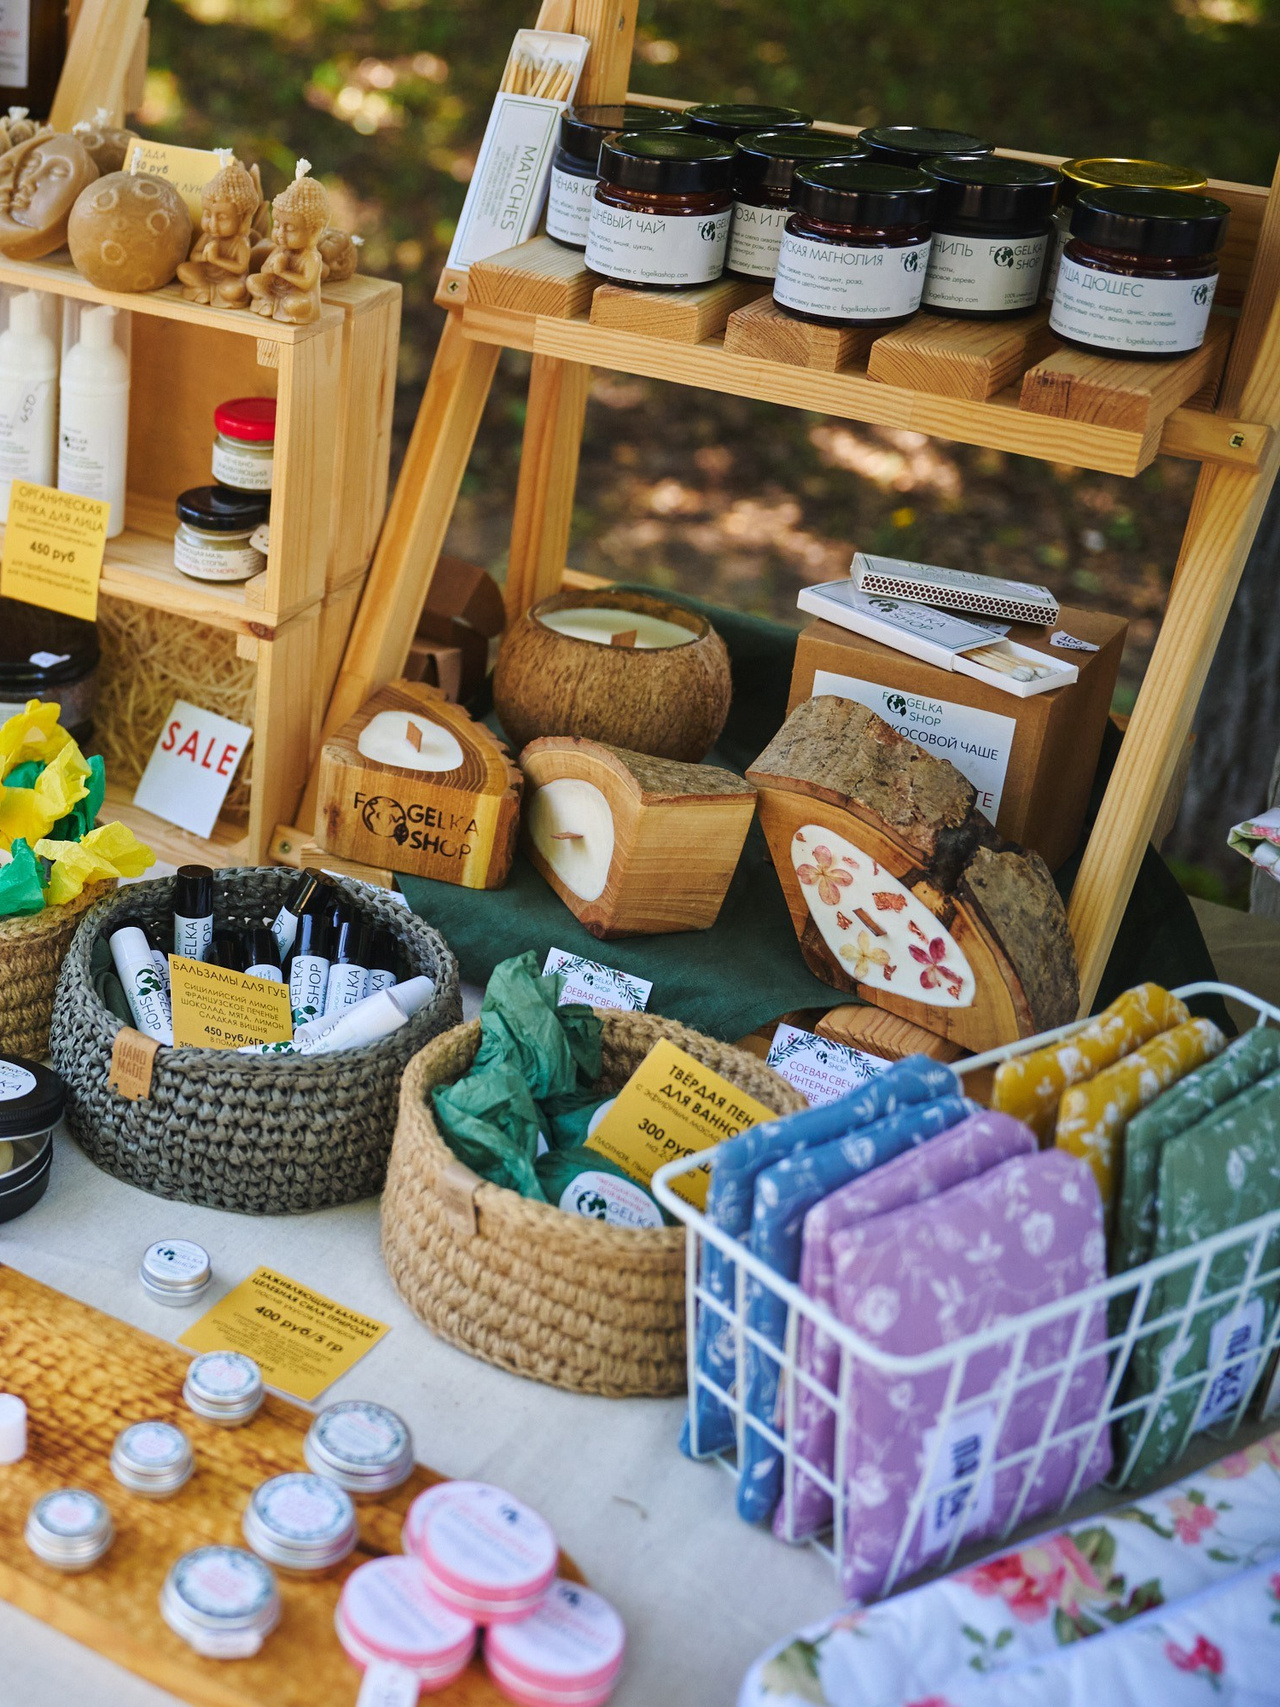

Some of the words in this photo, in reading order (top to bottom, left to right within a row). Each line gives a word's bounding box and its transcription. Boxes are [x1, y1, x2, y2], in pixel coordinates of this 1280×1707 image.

[501, 144, 538, 231] MATCHES
[636, 219, 666, 234] ЧАЙ
[809, 247, 884, 267] МАГНОЛИЯ
[1015, 256, 1041, 270] SHOP
[613, 266, 632, 275] вместе
[640, 267, 689, 279] fogelkashop.com
[846, 278, 864, 287] роза,
[927, 291, 979, 303] fogelkashop.com
[1081, 273, 1145, 299] ДЮШЕС
[811, 302, 830, 311] вместе
[840, 303, 891, 316] fogelkashop.com
[1125, 337, 1178, 347] fogelkashop.com
[20, 394, 37, 424] 450
[19, 486, 103, 517] ОРГАНИЧЕСКАЯ
[13, 500, 46, 516] ПЕНКА
[49, 511, 71, 523] ДЛЯ
[74, 516, 105, 533] ЛИЦА
[30, 541, 51, 556] 450
[52, 549, 76, 564] руб
[889, 612, 935, 632] SHOP
[909, 711, 942, 727] SHOP
[161, 719, 239, 779] SALE
[960, 740, 999, 761] ЧАШЕ
[408, 831, 472, 860] SHOP
[173, 960, 239, 987] БАЛЬЗАМЫ
[241, 980, 265, 994] ДЛЯ
[268, 985, 287, 999] ГУБ
[307, 963, 322, 1006] SHOP
[593, 982, 611, 993] SHOP
[184, 982, 247, 1005] СИЦИЛИЙСКИЙ
[249, 1000, 279, 1013] ЛИМОН
[185, 991, 245, 1012] ФРАНЦУЗСКОЕ
[246, 1007, 279, 1021] ПЕЧЕНЬЕ
[140, 996, 162, 1031] SHOP
[181, 998, 225, 1016] ШОКОЛАД,
[228, 1010, 252, 1023] МЯТА,
[254, 1016, 285, 1031] ЛИМОН
[198, 1010, 238, 1027] СЛАДКАЯ
[240, 1022, 268, 1034] ВИШНЯ
[204, 1025, 222, 1038] 450
[119, 1041, 147, 1065] HAND
[116, 1057, 145, 1081] MADE
[781, 1070, 789, 1078] В
[789, 1060, 828, 1081] СОЕВАЯ
[827, 1061, 847, 1073] SHOP
[643, 1087, 689, 1122] эфирным
[659, 1084, 692, 1107] ДЛЯ
[668, 1064, 727, 1109] ТВЁРДАЯ
[726, 1103, 755, 1128] ПЕН
[638, 1117, 665, 1142] 300
[646, 1141, 657, 1152] на
[252, 1277, 299, 1303] ЦЕЛЕБНАЯ
[299, 1300, 325, 1317] СИЛА
[327, 1314, 374, 1339] ПРИРОДЫ
[259, 1271, 335, 1311] ЗАЖИВЛЯЮЩИЙ
[335, 1308, 380, 1332] БАЛЬЗАМ
[255, 1306, 281, 1321] 400
[280, 1320, 326, 1343] руб/5
[326, 1341, 344, 1352] гр
